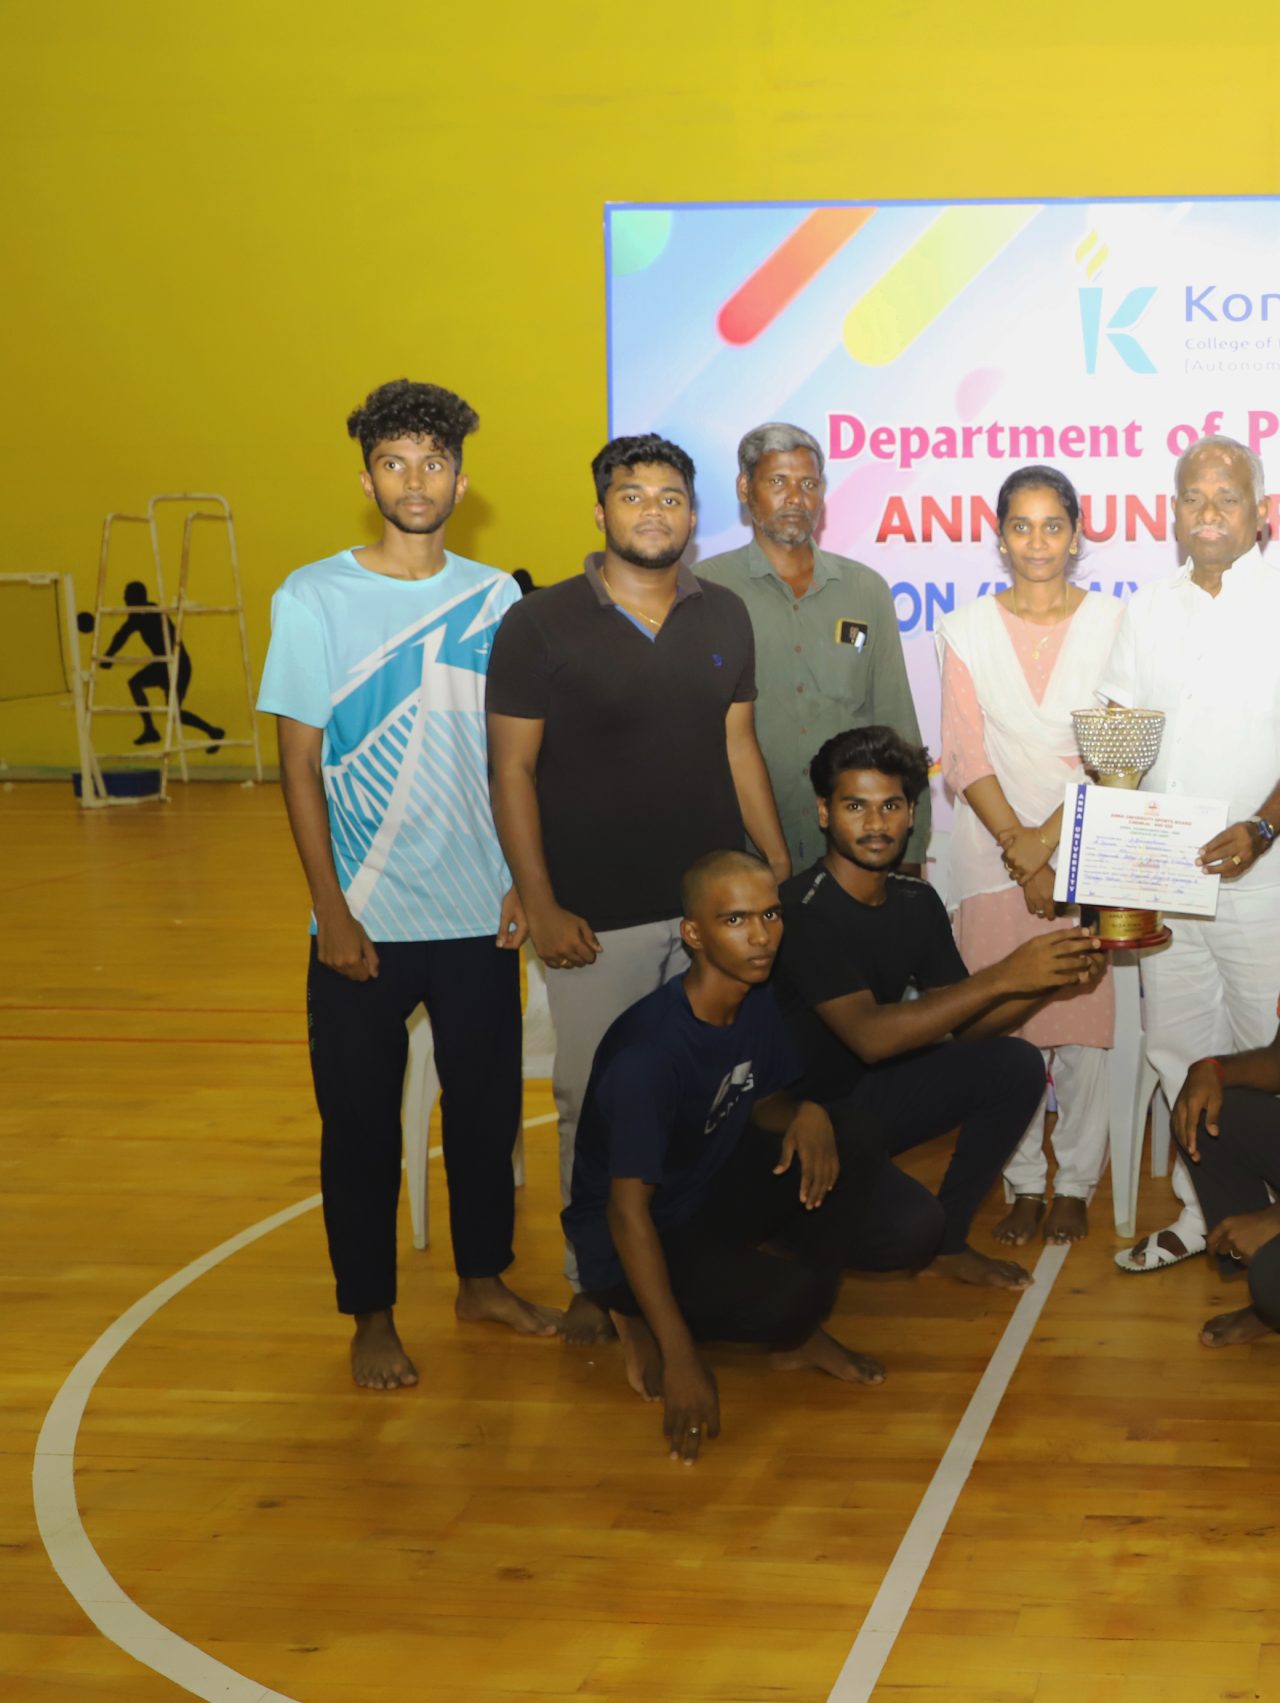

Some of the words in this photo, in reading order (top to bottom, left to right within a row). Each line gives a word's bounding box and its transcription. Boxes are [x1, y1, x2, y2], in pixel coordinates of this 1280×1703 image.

[1184, 336, 1249, 351] College
[1255, 335, 1271, 349] of
[828, 413, 1144, 469] Department
[875, 495, 1001, 543] ANN
[1076, 793, 1085, 820] ANNA
[1069, 826, 1081, 892] UNIVERSITY
